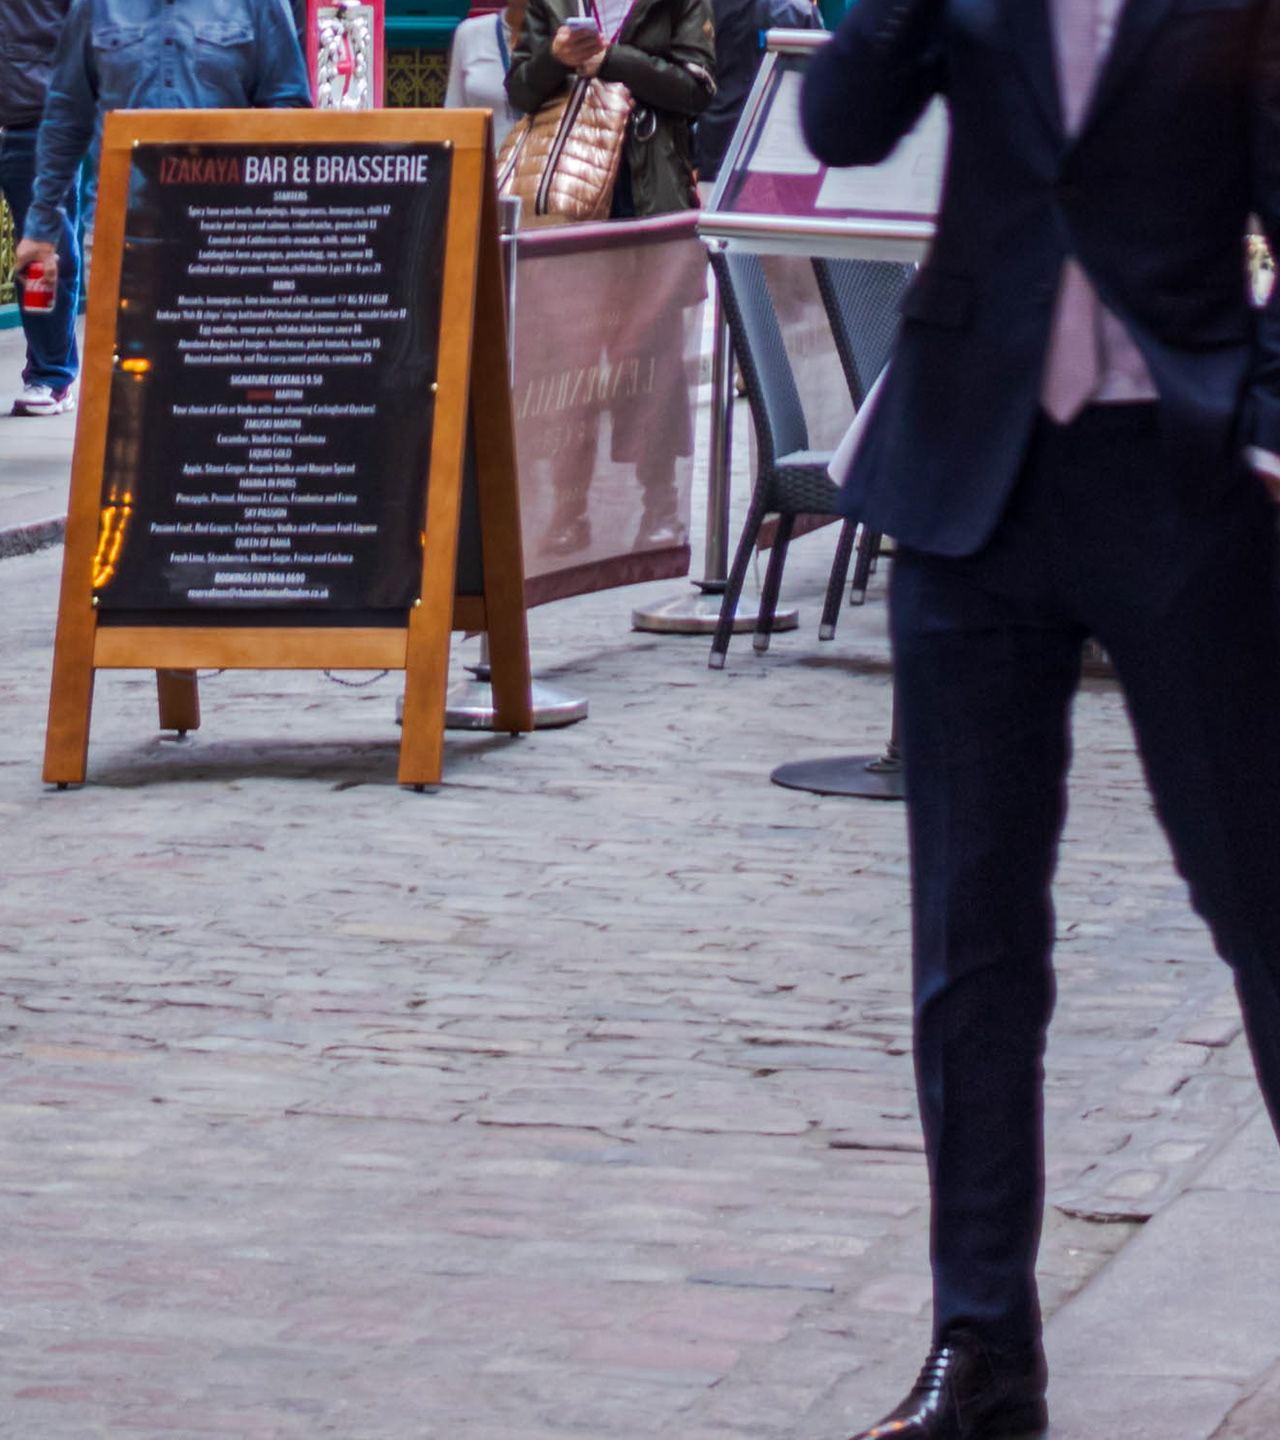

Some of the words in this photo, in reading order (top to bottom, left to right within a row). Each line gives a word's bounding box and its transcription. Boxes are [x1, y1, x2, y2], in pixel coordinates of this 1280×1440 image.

[160, 157, 240, 185] IZAKAYA
[245, 156, 287, 183] BAR
[293, 156, 310, 182] &
[316, 155, 428, 183] BRASSERIE
